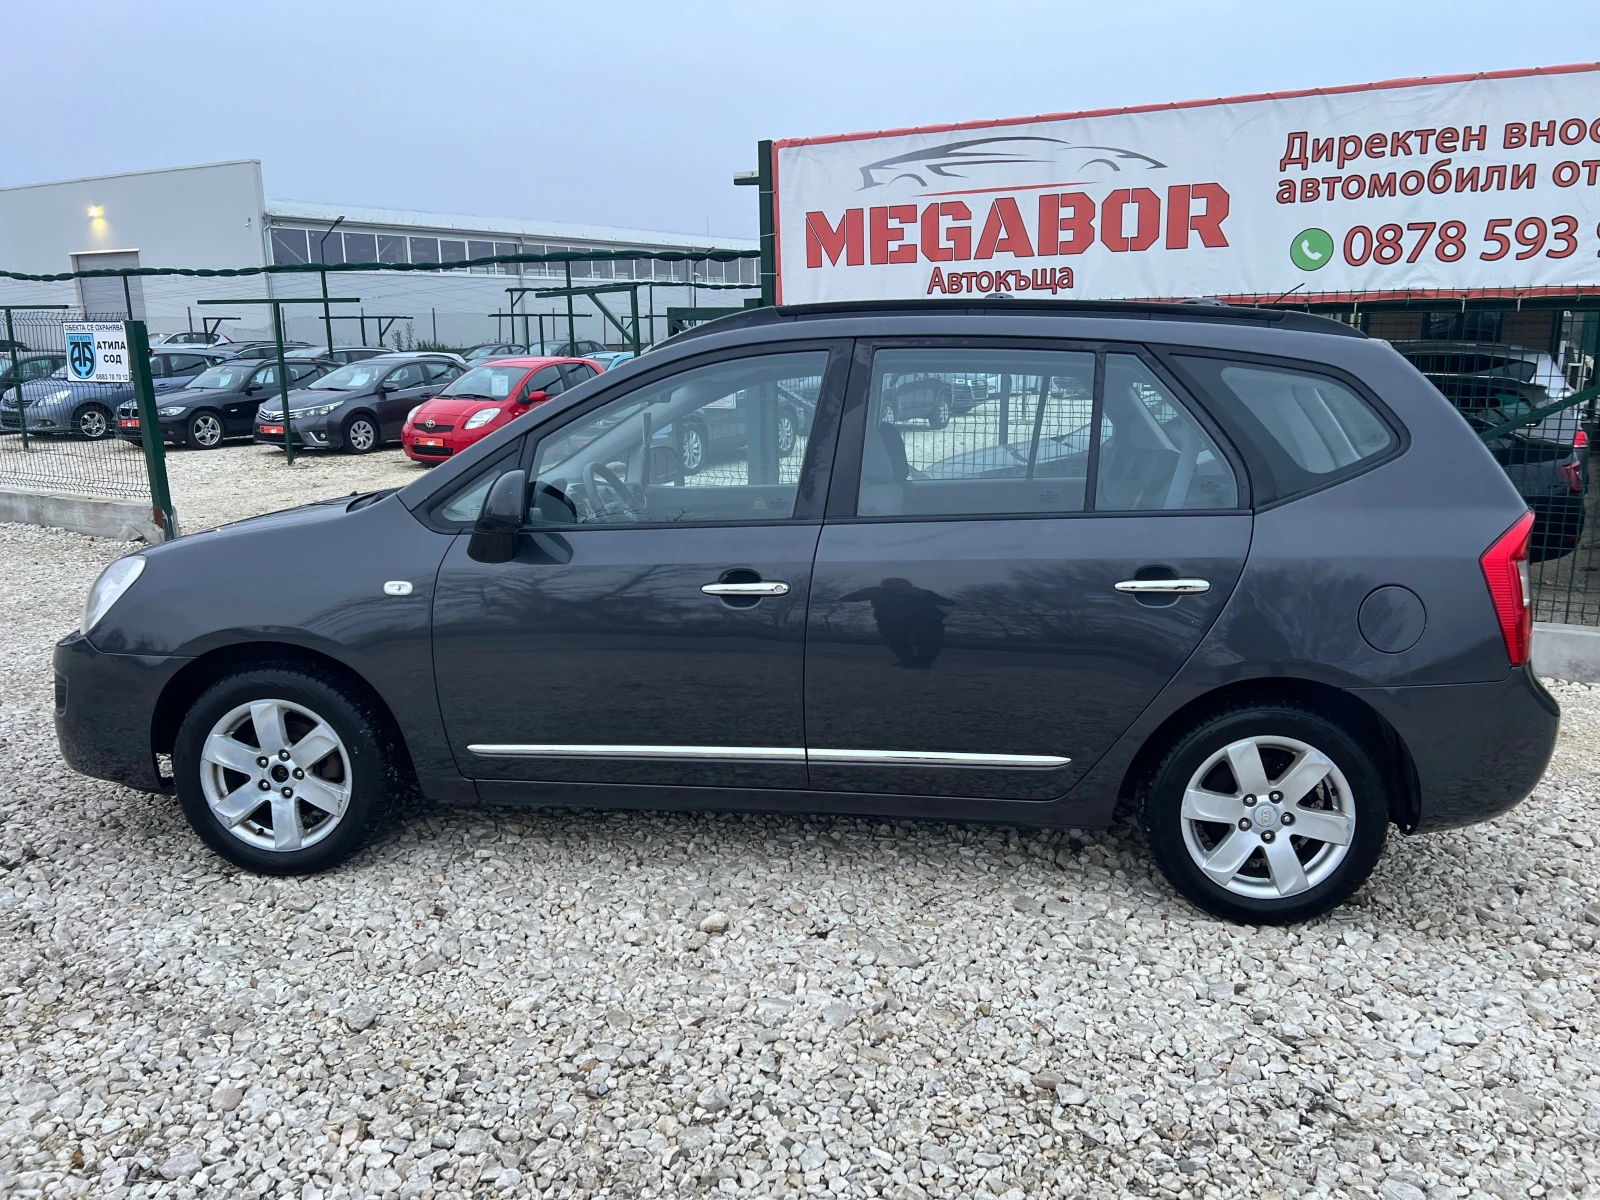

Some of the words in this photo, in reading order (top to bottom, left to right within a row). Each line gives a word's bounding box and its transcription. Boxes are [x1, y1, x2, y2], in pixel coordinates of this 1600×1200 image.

[1279, 125, 1487, 172] Директен
[1276, 158, 1537, 204] автомобили
[1552, 160, 1600, 188] от
[805, 182, 1230, 268] MEGABOR
[1343, 219, 1467, 267] 0878
[1479, 215, 1579, 262] 593
[927, 266, 1074, 295] Автокъща
[96, 340, 126, 350] АТИЛА
[103, 354, 122, 365] СОД
